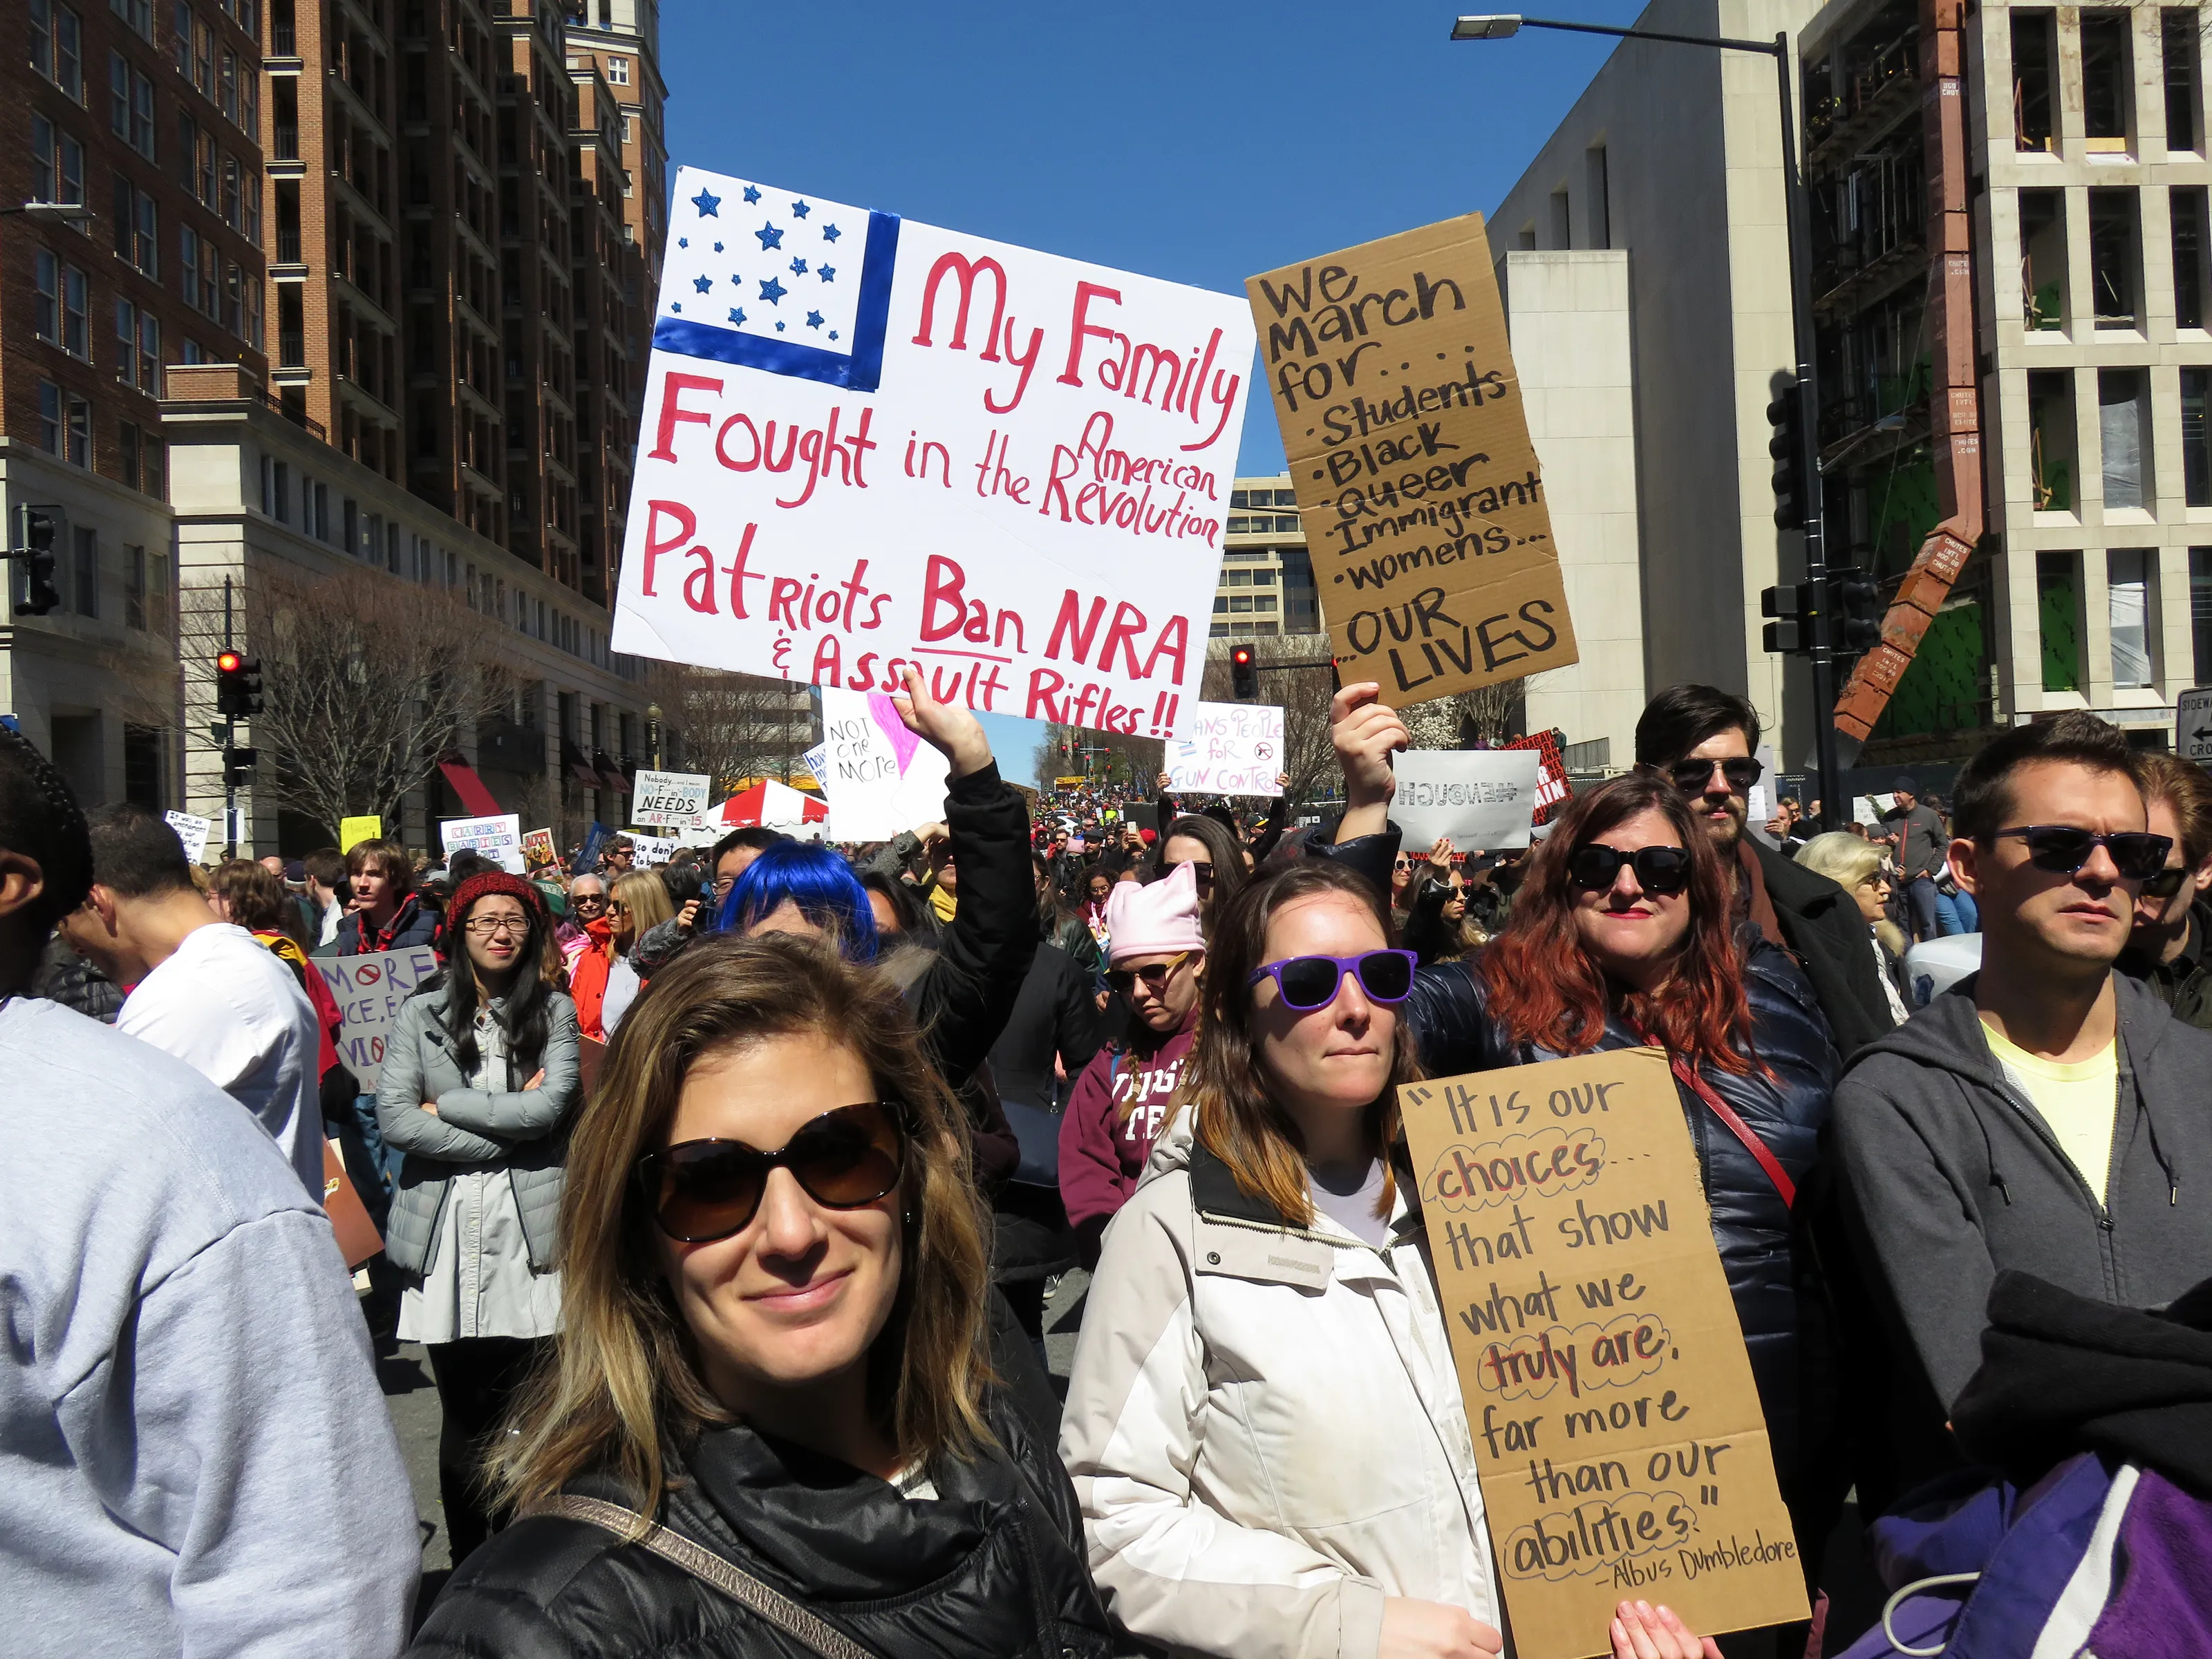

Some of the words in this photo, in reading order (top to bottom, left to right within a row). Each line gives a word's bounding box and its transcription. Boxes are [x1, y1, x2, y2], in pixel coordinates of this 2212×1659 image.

[1259, 265, 1358, 318] We
[1270, 272, 1465, 364] March
[912, 252, 1044, 413] My
[1057, 281, 1240, 451] Family
[1322, 359, 1507, 446] Students
[648, 370, 877, 509] Fought
[904, 430, 952, 488] in
[975, 429, 1030, 505] the
[1077, 411, 1217, 500] American
[1327, 422, 1460, 487] Black
[1040, 444, 1221, 549] Revolution
[1333, 471, 1542, 555] Immigrant
[1335, 452, 1490, 521] Queer
[641, 500, 893, 633] Patriots
[919, 554, 1028, 655] Ban
[1044, 588, 1189, 686] NRA
[1387, 600, 1557, 691] LIVES
[812, 634, 1009, 711] Assault
[1026, 668, 1180, 738] Rifles!!
[830, 718, 870, 740] NOT
[1194, 717, 1228, 735] ANS
[1231, 709, 1284, 738] PEOPLE
[642, 796, 696, 812] NEEDS
[1170, 765, 1210, 789] GUN
[1217, 766, 1282, 793] CONTROL
[1535, 779, 1566, 809] AIN
[447, 834, 513, 852] BABIES
[451, 821, 506, 838] CARRY
[652, 841, 675, 855] don't
[1125, 1105, 1166, 1141] TE
[1490, 1089, 1530, 1127] is
[1548, 1082, 1624, 1118] our
[1446, 1205, 1535, 1271] that
[1558, 1199, 1668, 1248] show
[1459, 1269, 1562, 1335] what
[1577, 1272, 1646, 1309] we
[1484, 1331, 1580, 1398] truly
[1481, 1405, 1544, 1459] far
[1566, 1389, 1689, 1435] more
[1525, 1456, 1630, 1507] than
[1648, 1443, 1732, 1481] our
[1678, 1528, 1797, 1580] Dumbledore
